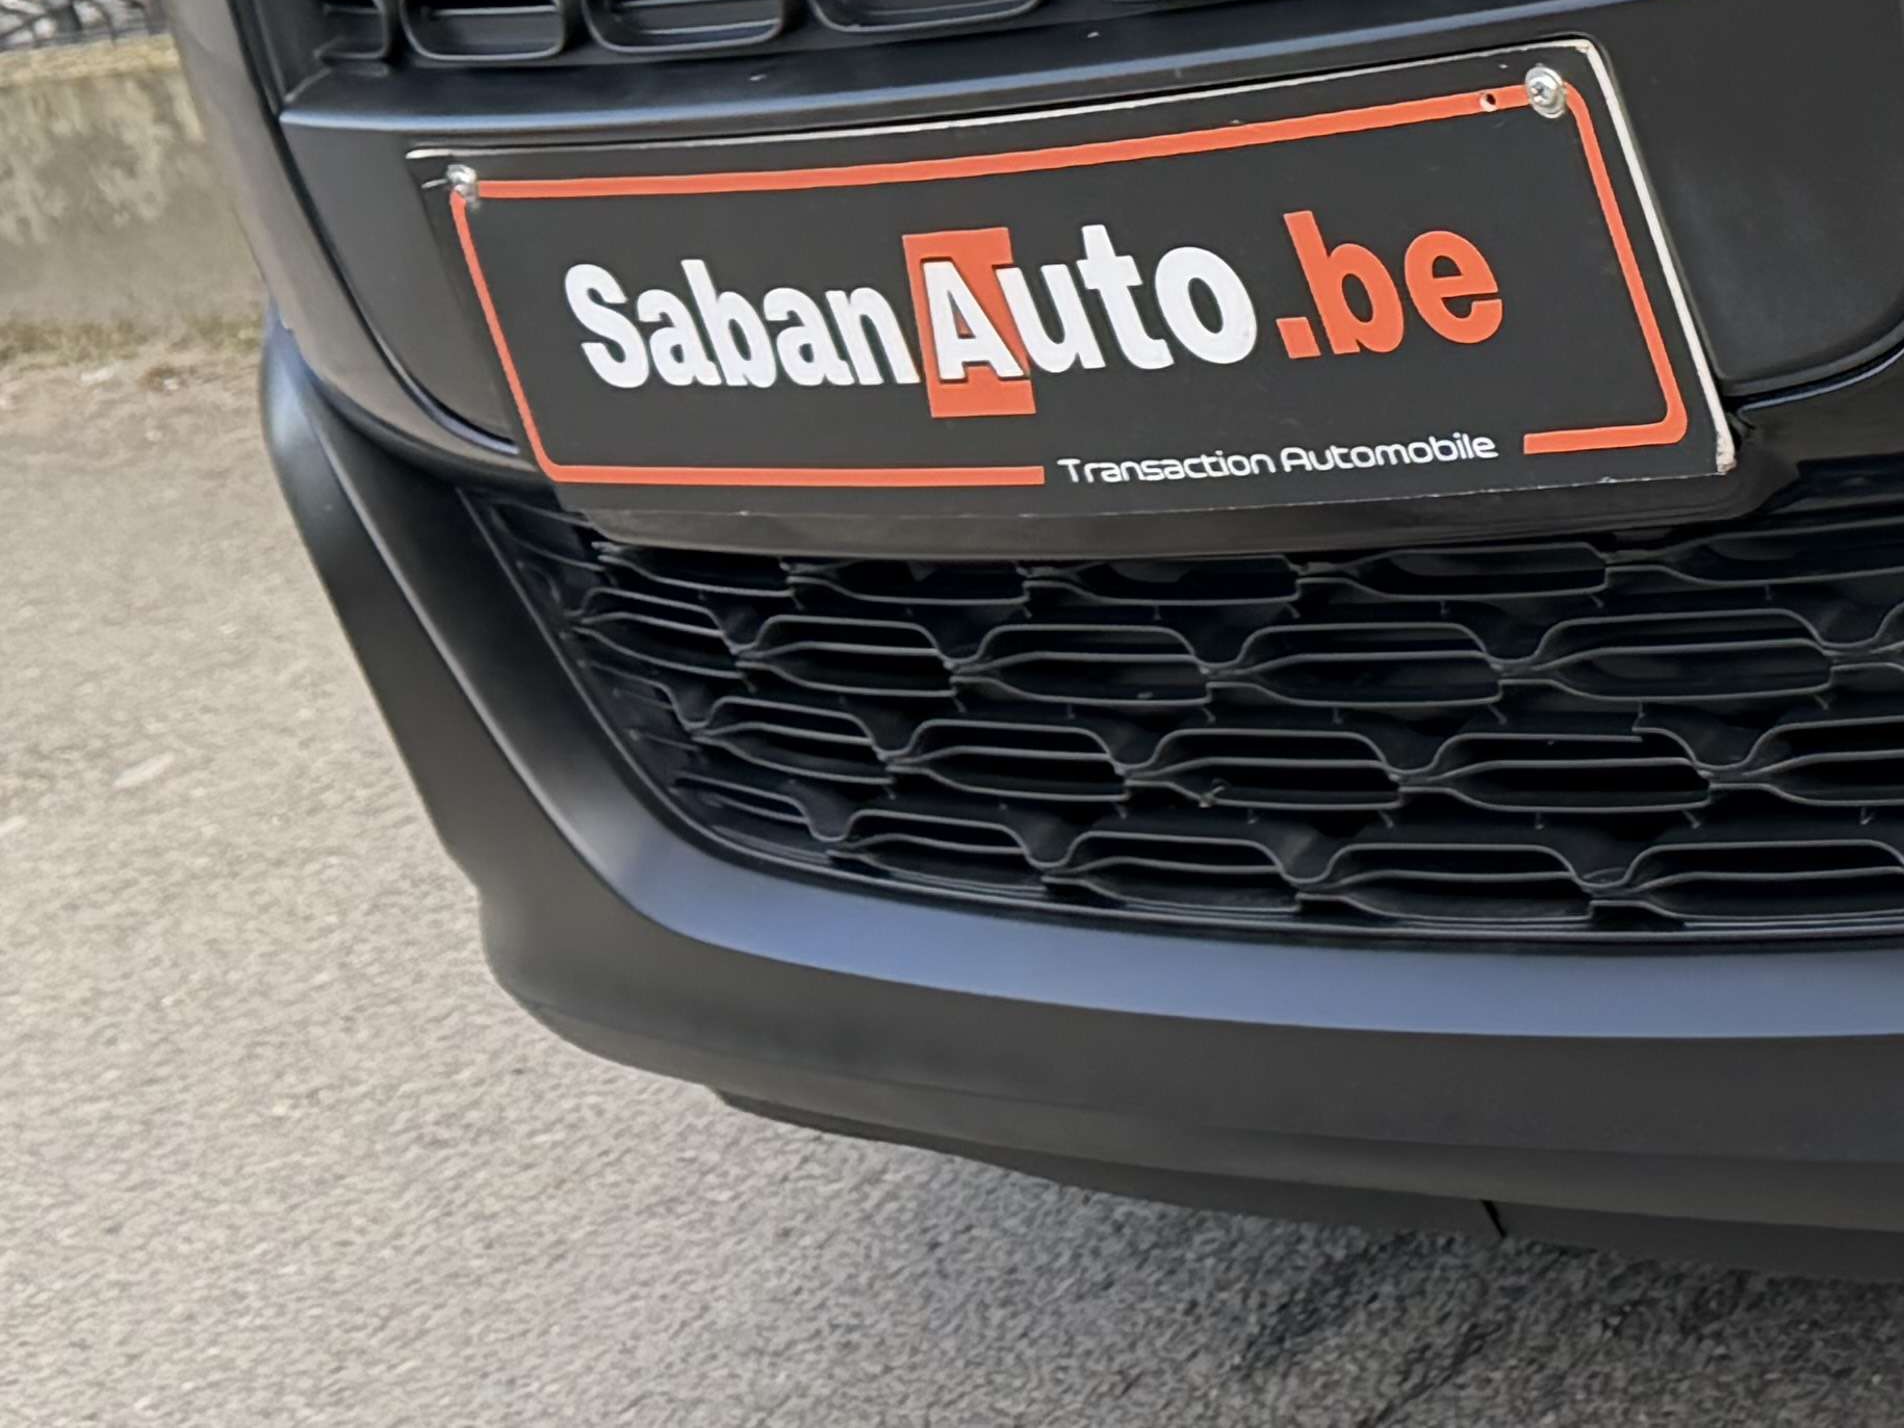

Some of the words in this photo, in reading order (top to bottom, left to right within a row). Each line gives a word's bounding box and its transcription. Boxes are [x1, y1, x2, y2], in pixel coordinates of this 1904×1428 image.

[564, 210, 1504, 390] SabanAuto.be
[1057, 449, 1277, 484] Transaction
[1281, 431, 1500, 473] Automobile
